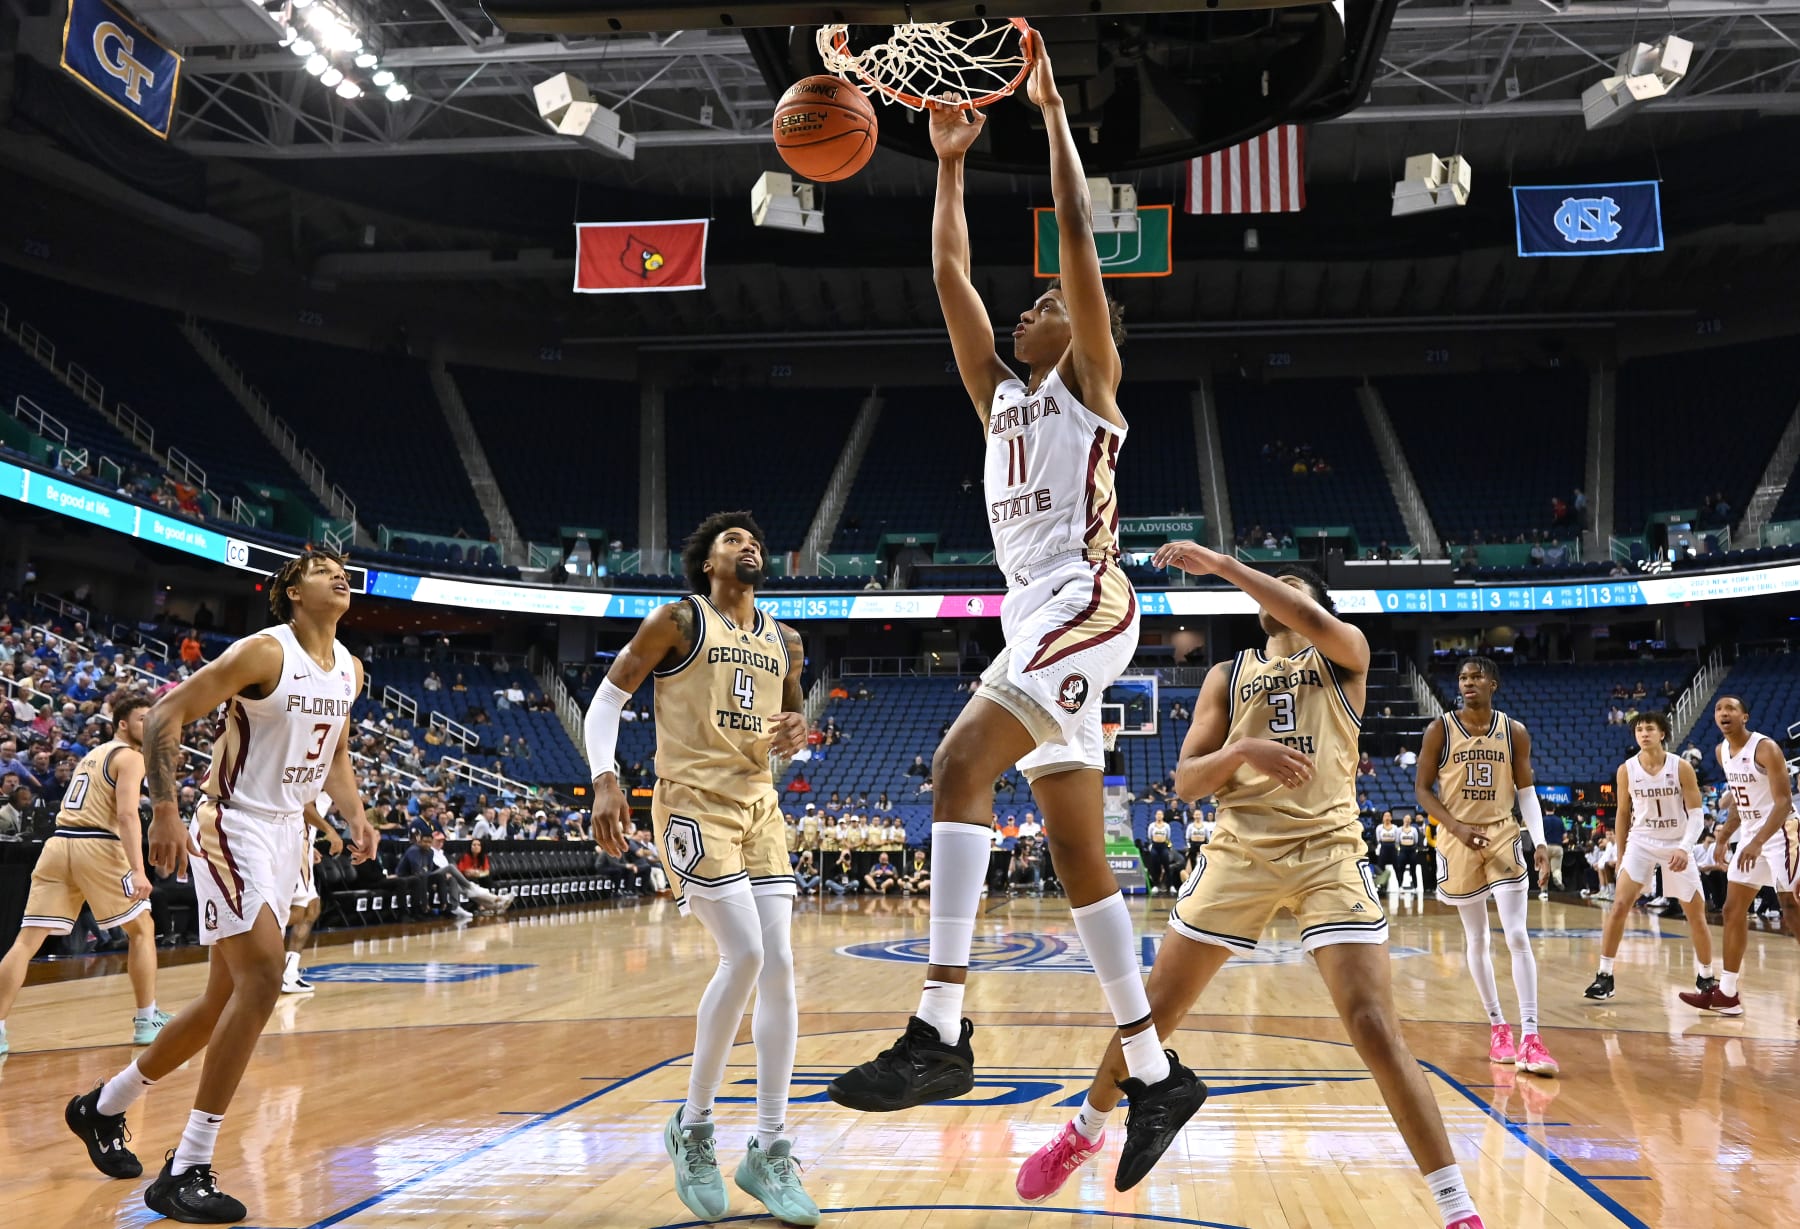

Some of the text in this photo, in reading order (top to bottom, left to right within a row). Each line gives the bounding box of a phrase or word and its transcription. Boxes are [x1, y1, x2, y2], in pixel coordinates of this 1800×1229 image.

[93, 21, 154, 105] GT
[776, 111, 828, 128] LEGACY
[771, 365, 792, 377] 223
[1007, 433, 1027, 489] 11
[46, 486, 111, 518] Be good at life.
[991, 488, 1051, 523] STATE
[154, 520, 165, 534] Be
[165, 526, 185, 540] good
[186, 532, 194, 543] at
[195, 533, 207, 548] life.
[1137, 523, 1194, 532] ADVISORS
[1387, 593, 1399, 609] 0
[1440, 593, 1447, 608] 1
[1490, 592, 1501, 607] 3
[1542, 590, 1553, 606] 4
[1591, 587, 1611, 604] 13
[618, 599, 625, 614] 1
[759, 601, 779, 617] 22
[807, 601, 827, 616] 35
[895, 601, 920, 612] 5-21
[708, 646, 779, 677] GEORGIA
[733, 667, 755, 710] 4
[1240, 669, 1323, 703] GEORGIA
[286, 694, 353, 717] FLORID
[1267, 692, 1296, 733] 3
[716, 710, 763, 733] TECH
[306, 723, 332, 760] 3
[1453, 749, 1506, 764] GEORGIA
[282, 763, 326, 784] STAE
[1465, 762, 1493, 787] 13
[64, 772, 90, 811] 0
[1461, 788, 1497, 801] TECH
[1633, 786, 1680, 798] FLORIDA
[1656, 799, 1662, 818] 1
[1645, 818, 1679, 829] STATE
